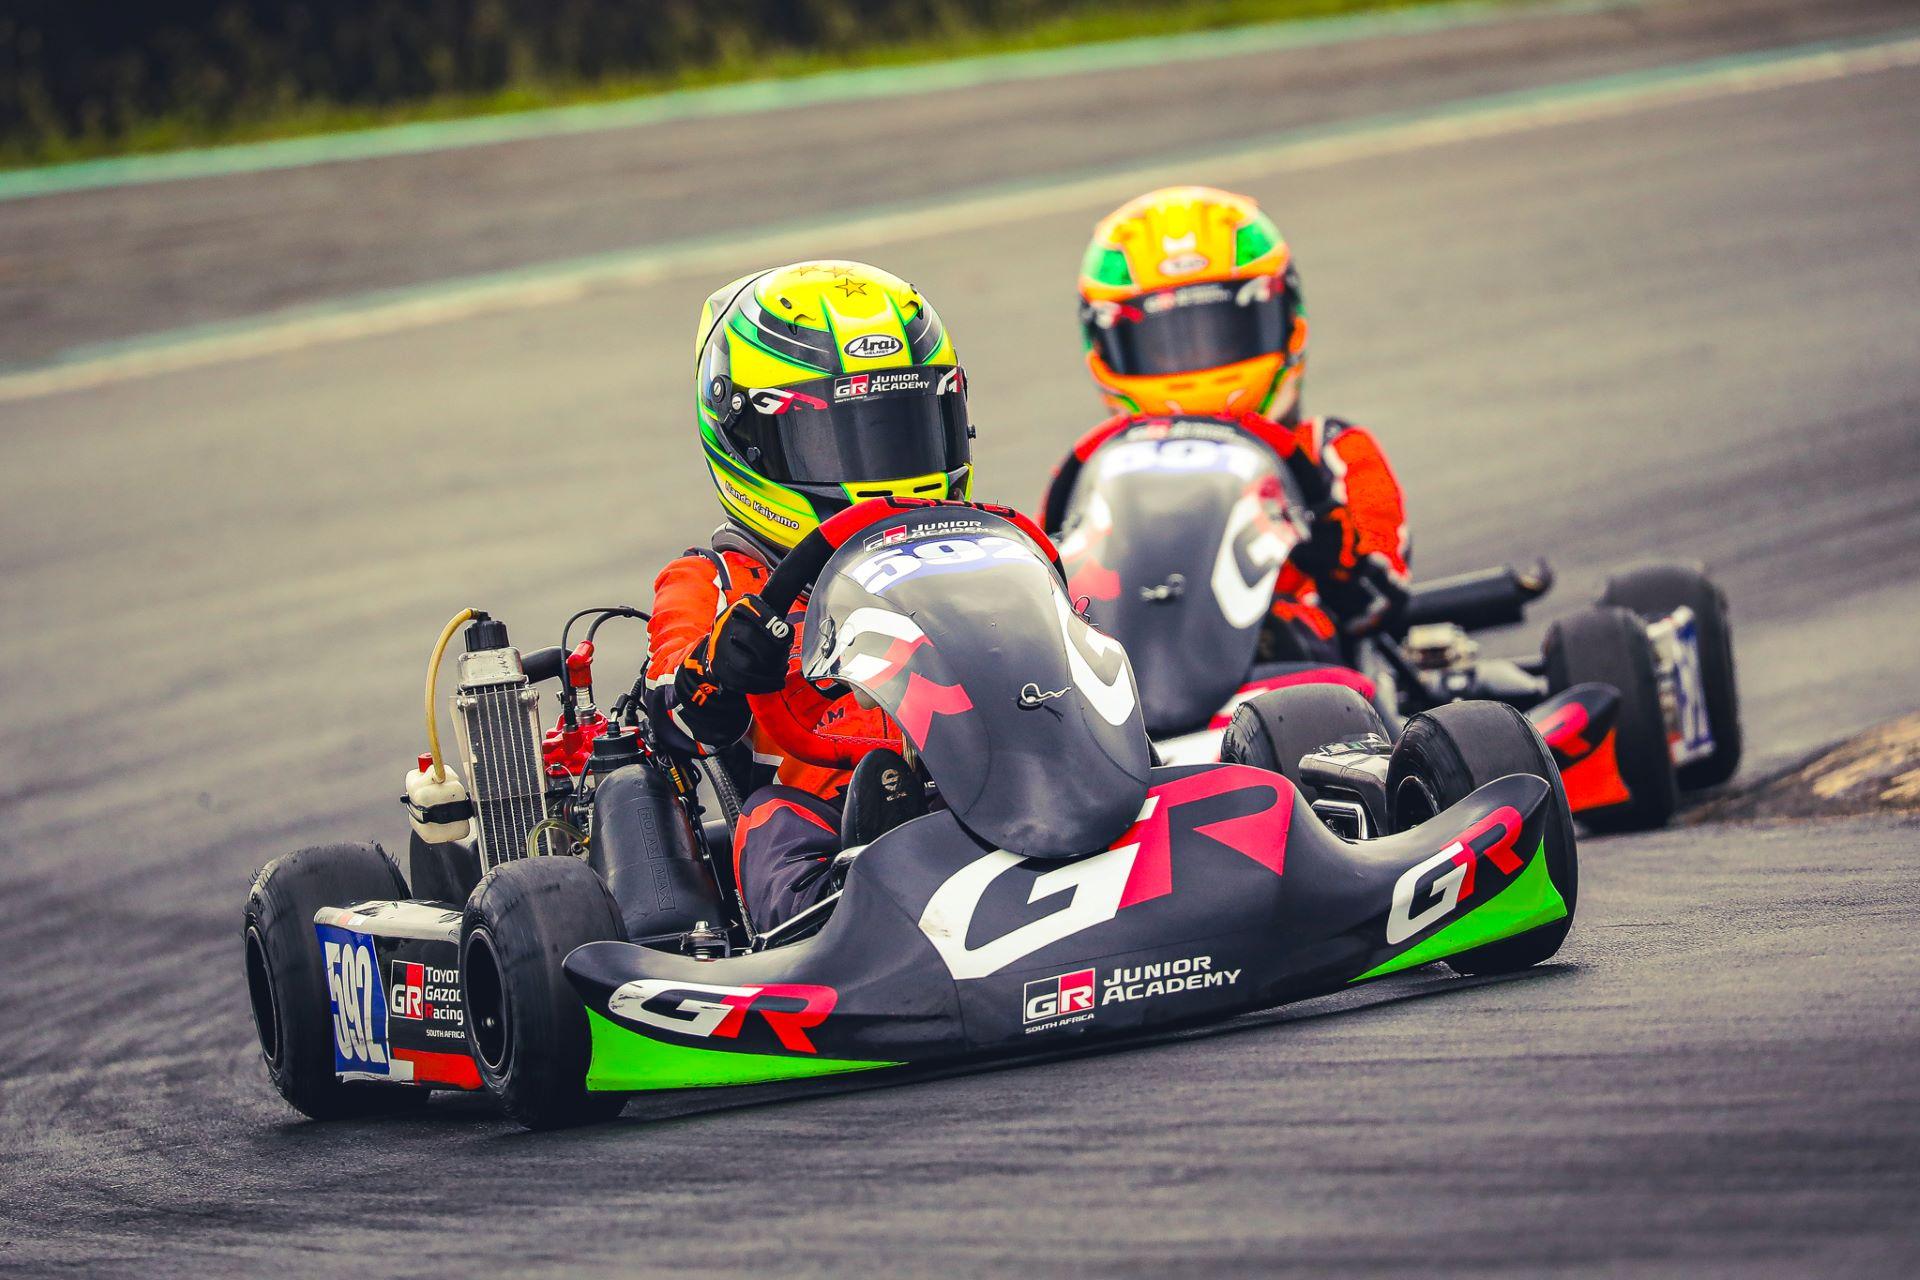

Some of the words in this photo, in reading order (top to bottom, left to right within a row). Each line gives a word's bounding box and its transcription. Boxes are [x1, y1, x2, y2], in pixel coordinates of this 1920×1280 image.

[850, 337, 897, 354] Arai
[836, 381, 868, 398] GR
[870, 381, 930, 393] ACADEMY
[872, 373, 919, 384] JUNIOR
[753, 501, 800, 530] Kaiyamo
[911, 520, 982, 533] JUNIOR
[910, 526, 1001, 539] ACADEMY
[852, 537, 1042, 594] 592
[654, 866, 674, 905] MAX
[917, 765, 1295, 980] GR
[1386, 806, 1524, 945] GR
[425, 966, 459, 984] TOYOT
[1103, 956, 1212, 987] JUNIOR
[324, 941, 387, 1064] 592
[391, 983, 422, 1016] GR
[1026, 985, 1094, 1020] GR
[1101, 969, 1242, 1006] ACADEMY
[425, 1003, 464, 1026] Racing
[608, 978, 839, 1054] GR
[1025, 1021, 1058, 1034] SOUTH
[1058, 1013, 1095, 1027] AFRICA
[426, 1029, 444, 1038] SOUTH
[444, 1030, 466, 1039] AFRICA
